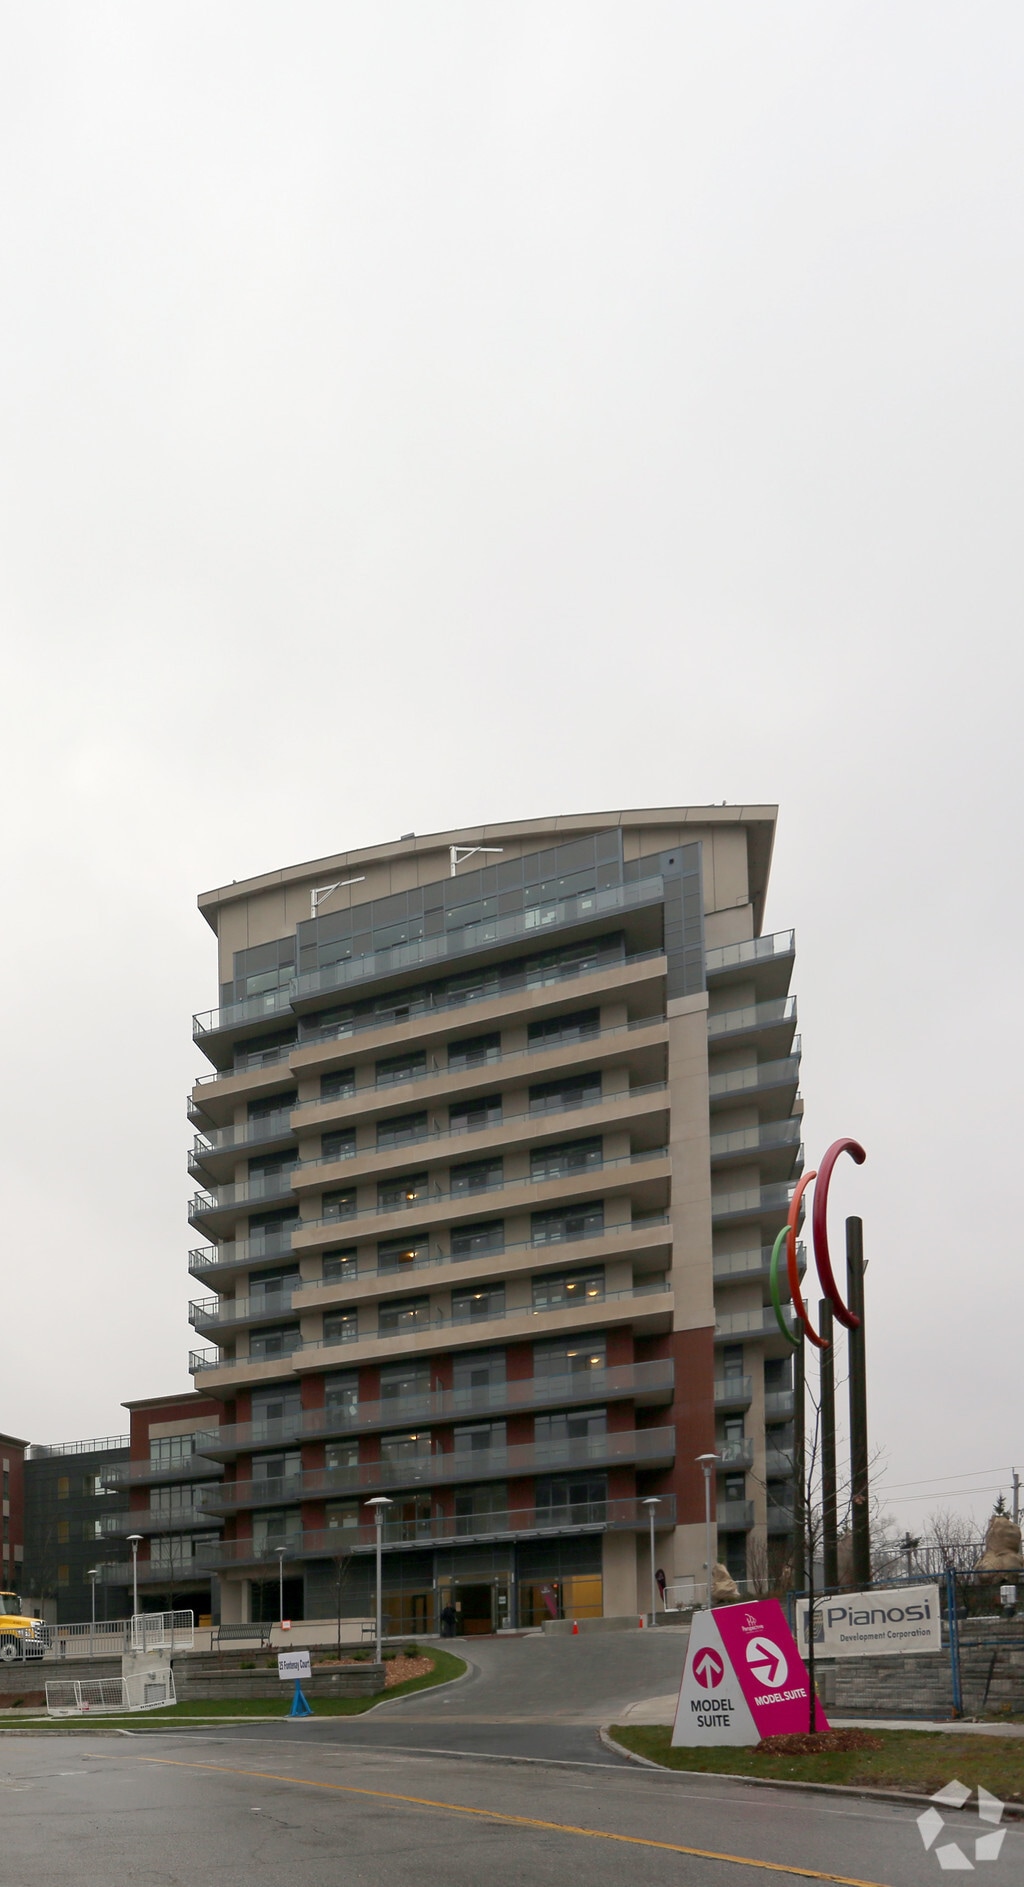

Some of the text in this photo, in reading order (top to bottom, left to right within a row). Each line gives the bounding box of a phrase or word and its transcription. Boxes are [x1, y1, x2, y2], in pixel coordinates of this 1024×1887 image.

[827, 1599, 931, 1628] Pianosi
[840, 1628, 931, 1642] Development Corporation
[754, 1688, 807, 1706] MODEL SUITE
[691, 1699, 734, 1712] MODEL
[697, 1715, 730, 1727] SUITE
